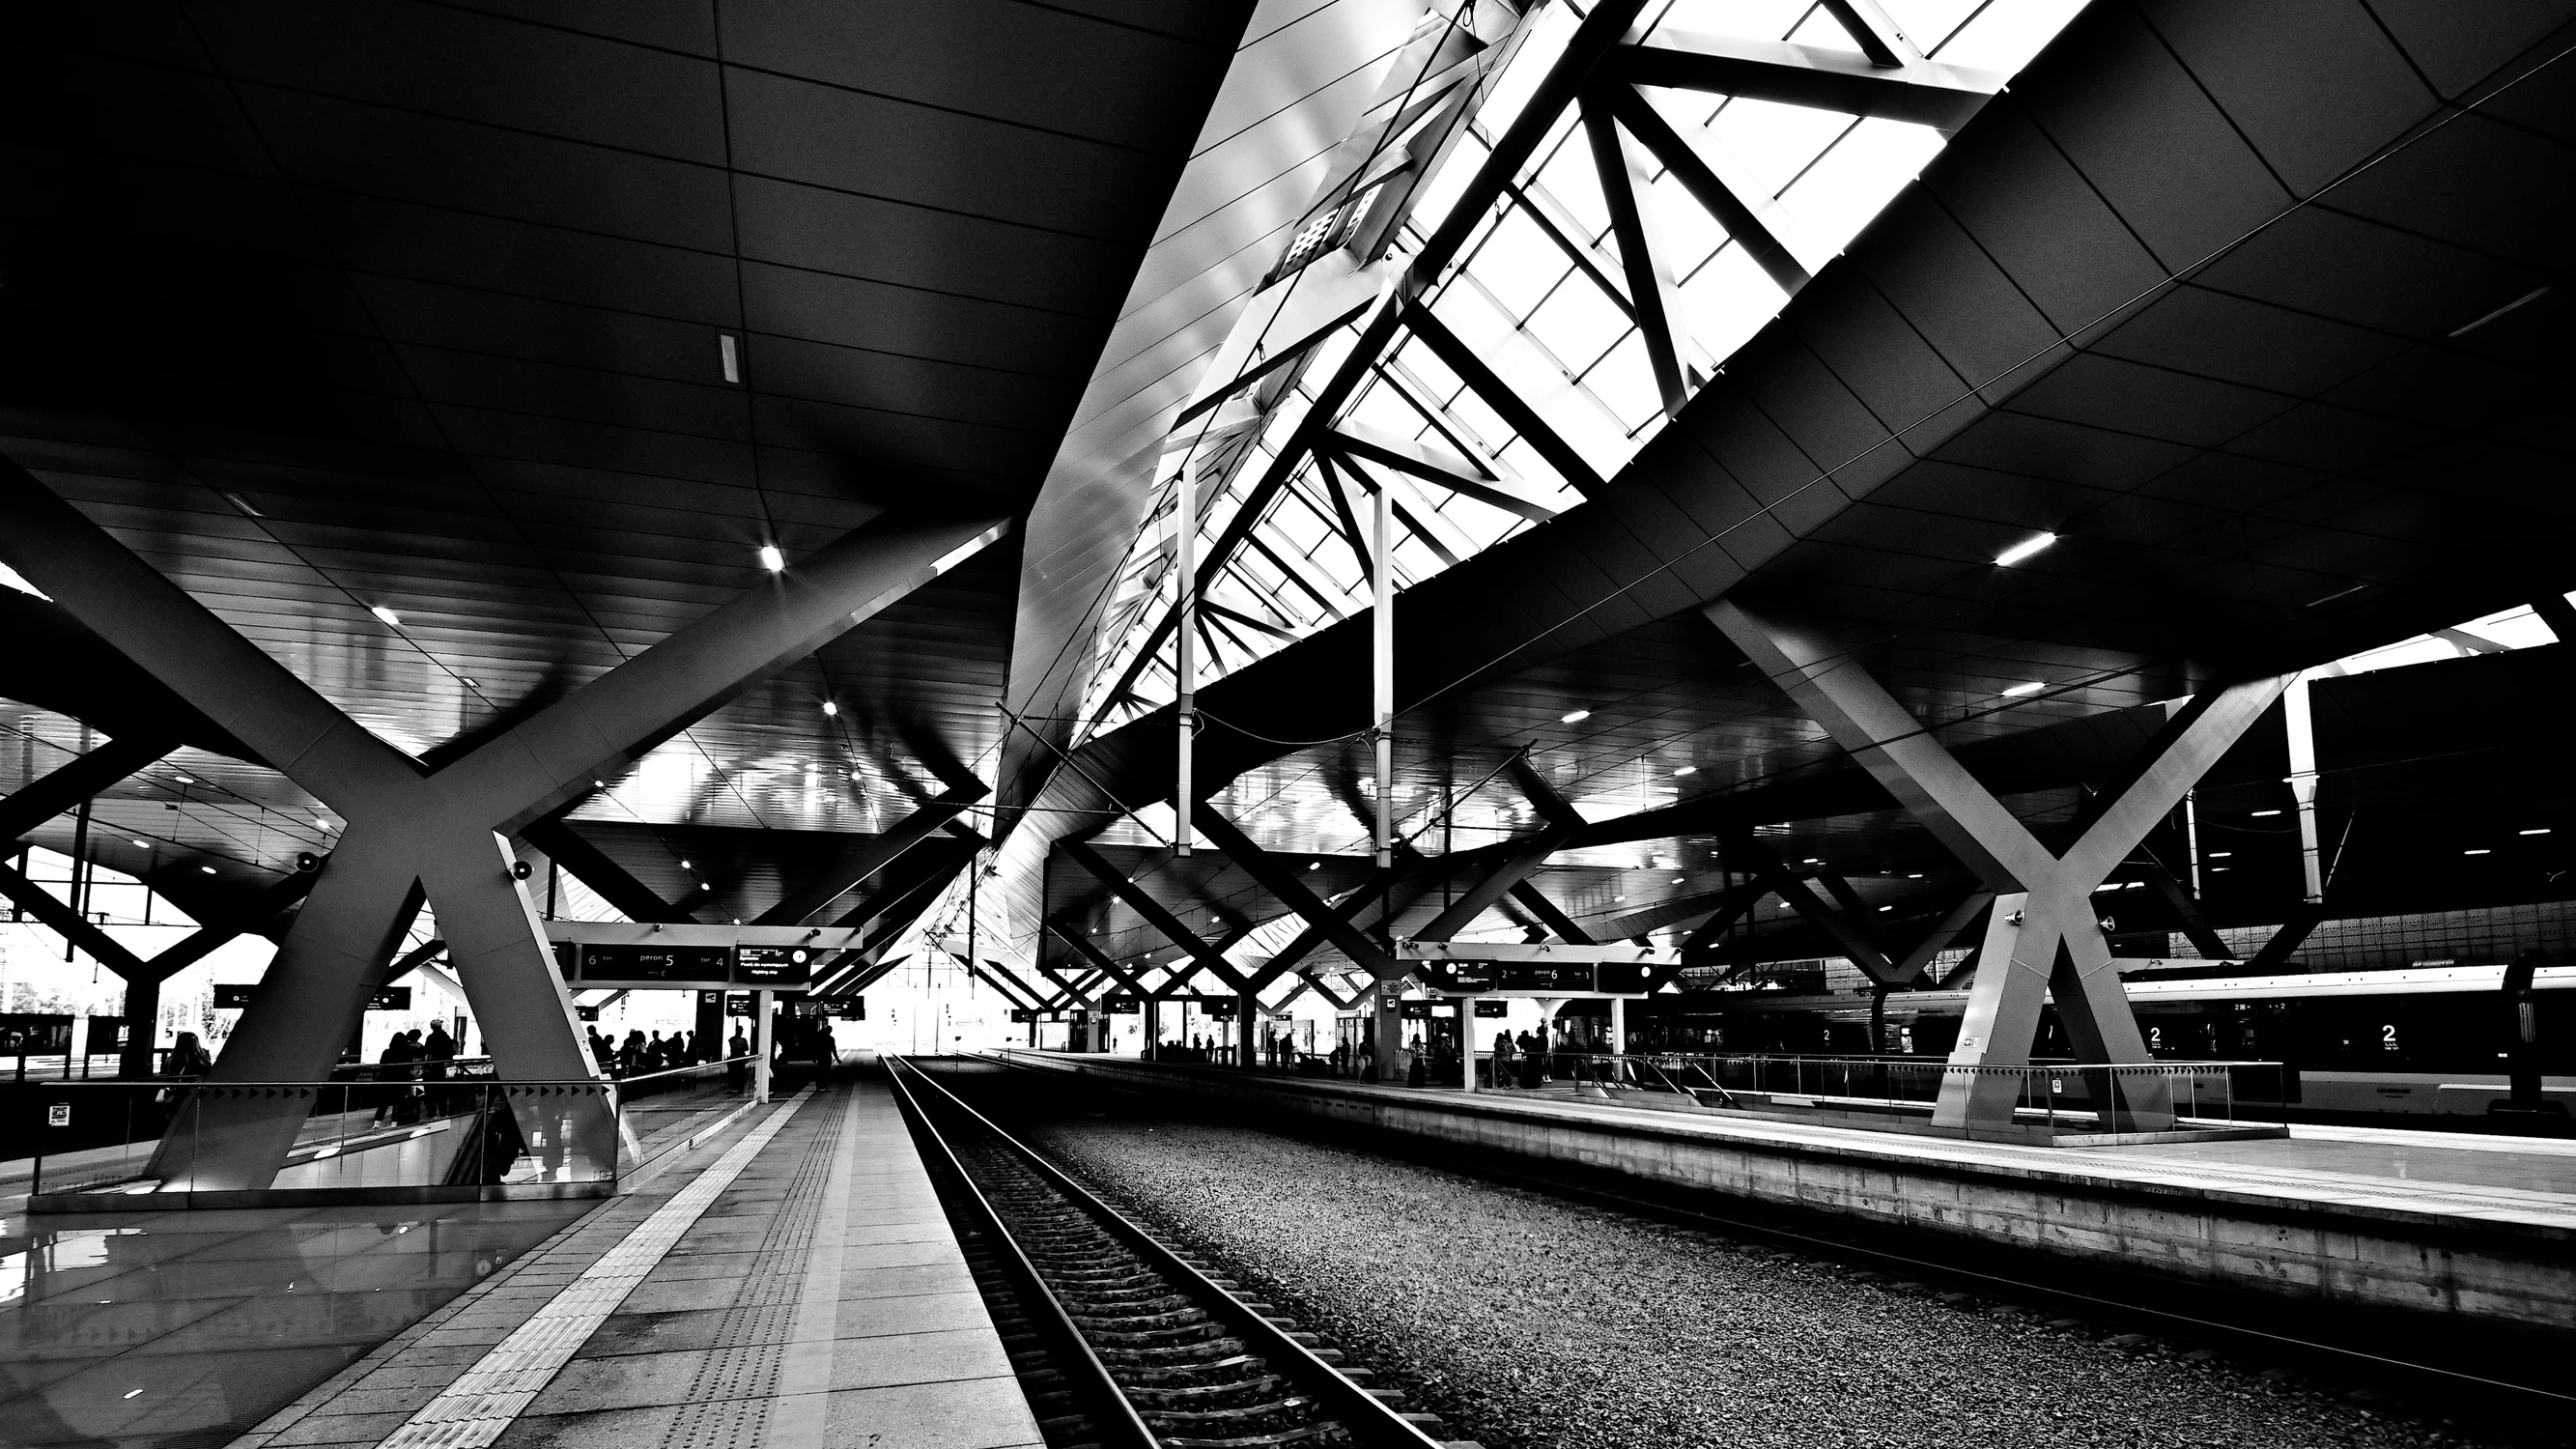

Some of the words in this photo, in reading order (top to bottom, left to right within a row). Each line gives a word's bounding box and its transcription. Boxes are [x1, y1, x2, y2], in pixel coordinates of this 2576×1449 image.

[588, 954, 597, 965] 6
[665, 954, 674, 967] 5
[716, 956, 724, 967] 4
[1501, 970, 1508, 979] 2
[1550, 969, 1558, 980] 6
[1585, 971, 1590, 980] 1
[1823, 1029, 1830, 1040] 2
[2150, 1027, 2161, 1041] 2
[2382, 1024, 2396, 1041] 2
